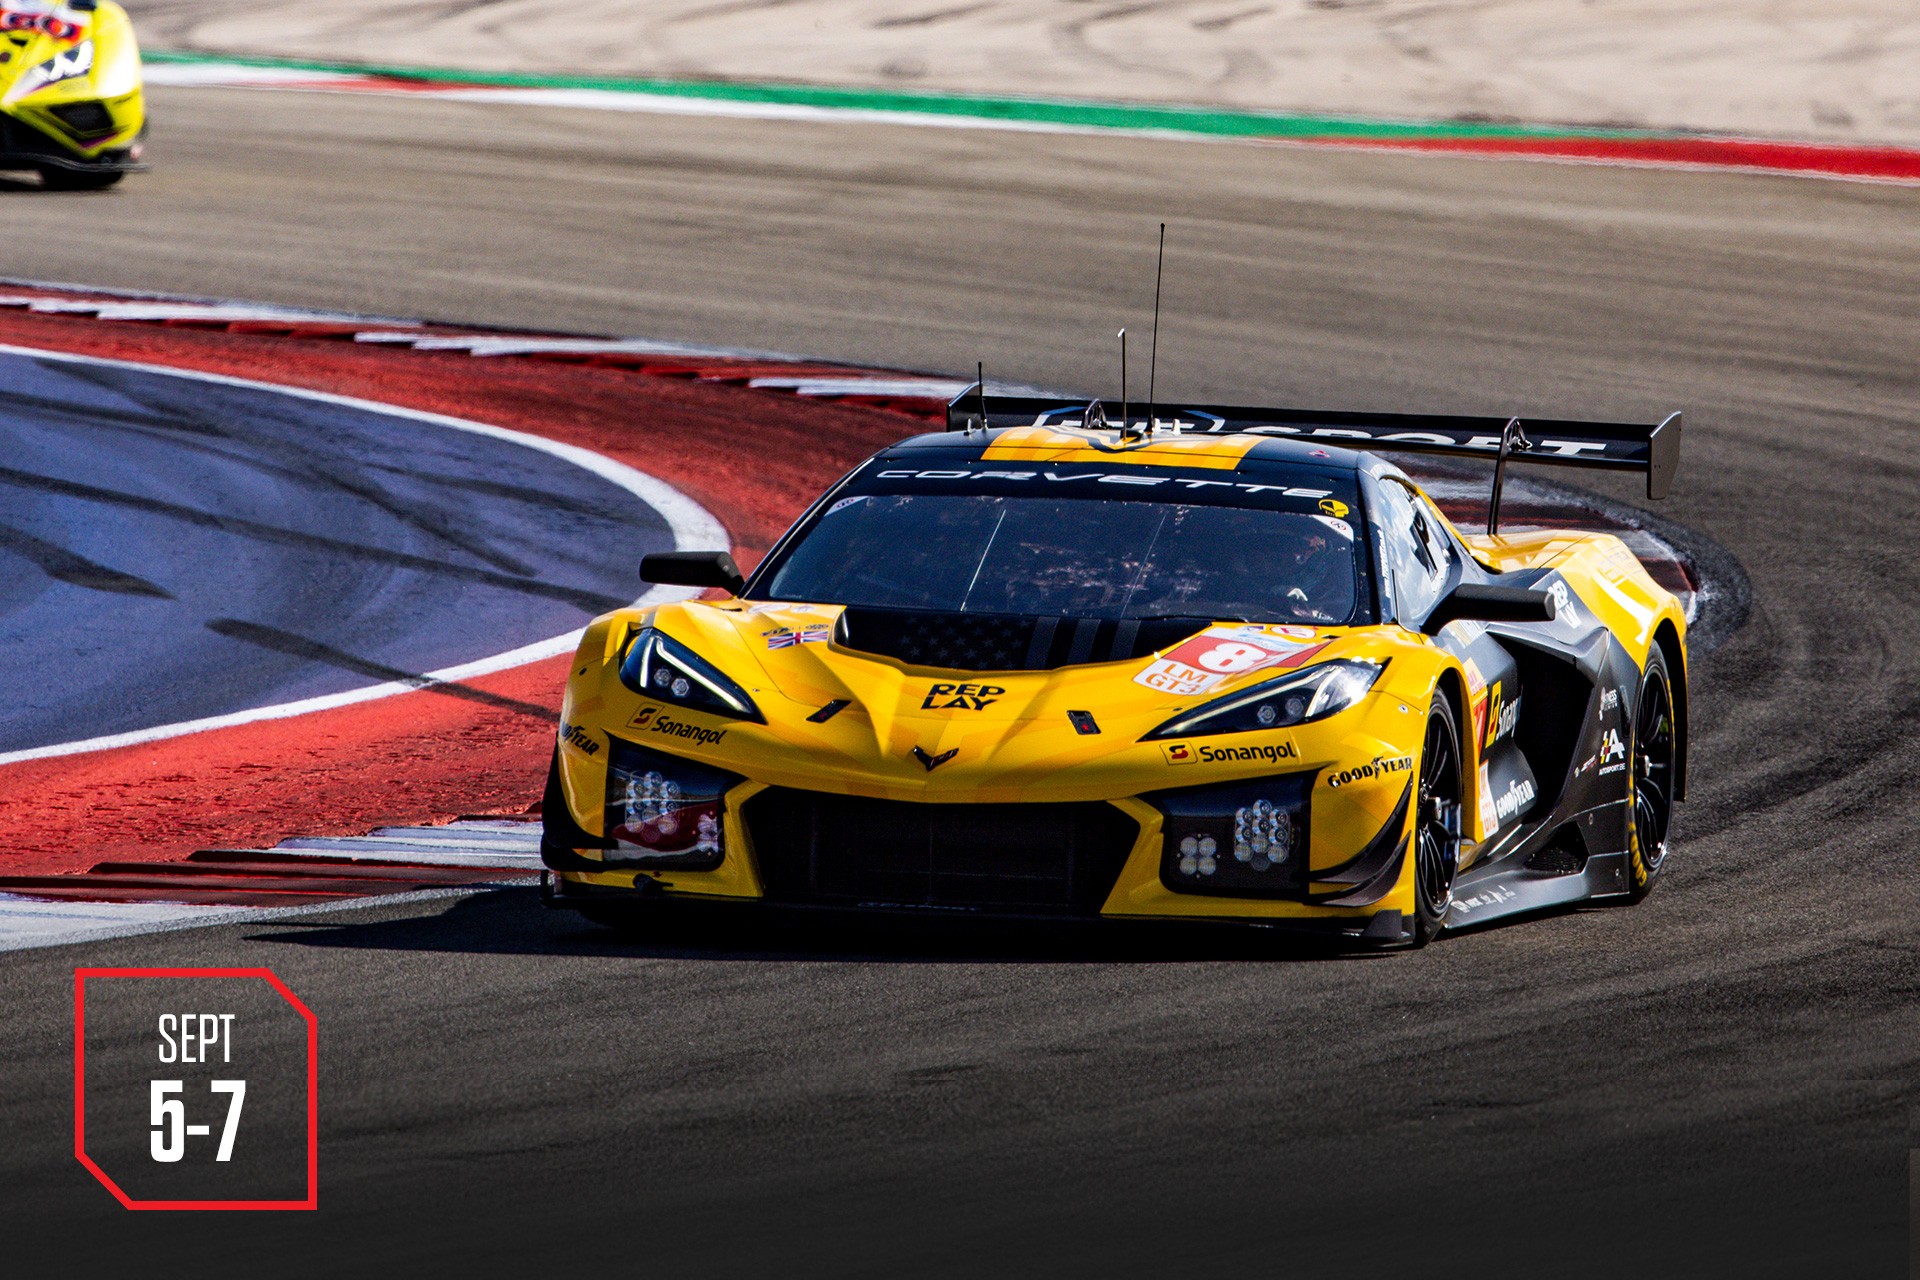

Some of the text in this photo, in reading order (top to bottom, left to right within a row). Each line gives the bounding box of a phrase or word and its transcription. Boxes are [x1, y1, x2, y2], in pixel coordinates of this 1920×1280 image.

[876, 469, 1333, 498] CORVETTE
[1145, 673, 1201, 694] GT3
[1163, 663, 1209, 683] LM
[651, 716, 727, 746] Sonangol
[1199, 741, 1296, 764] Sonangol
